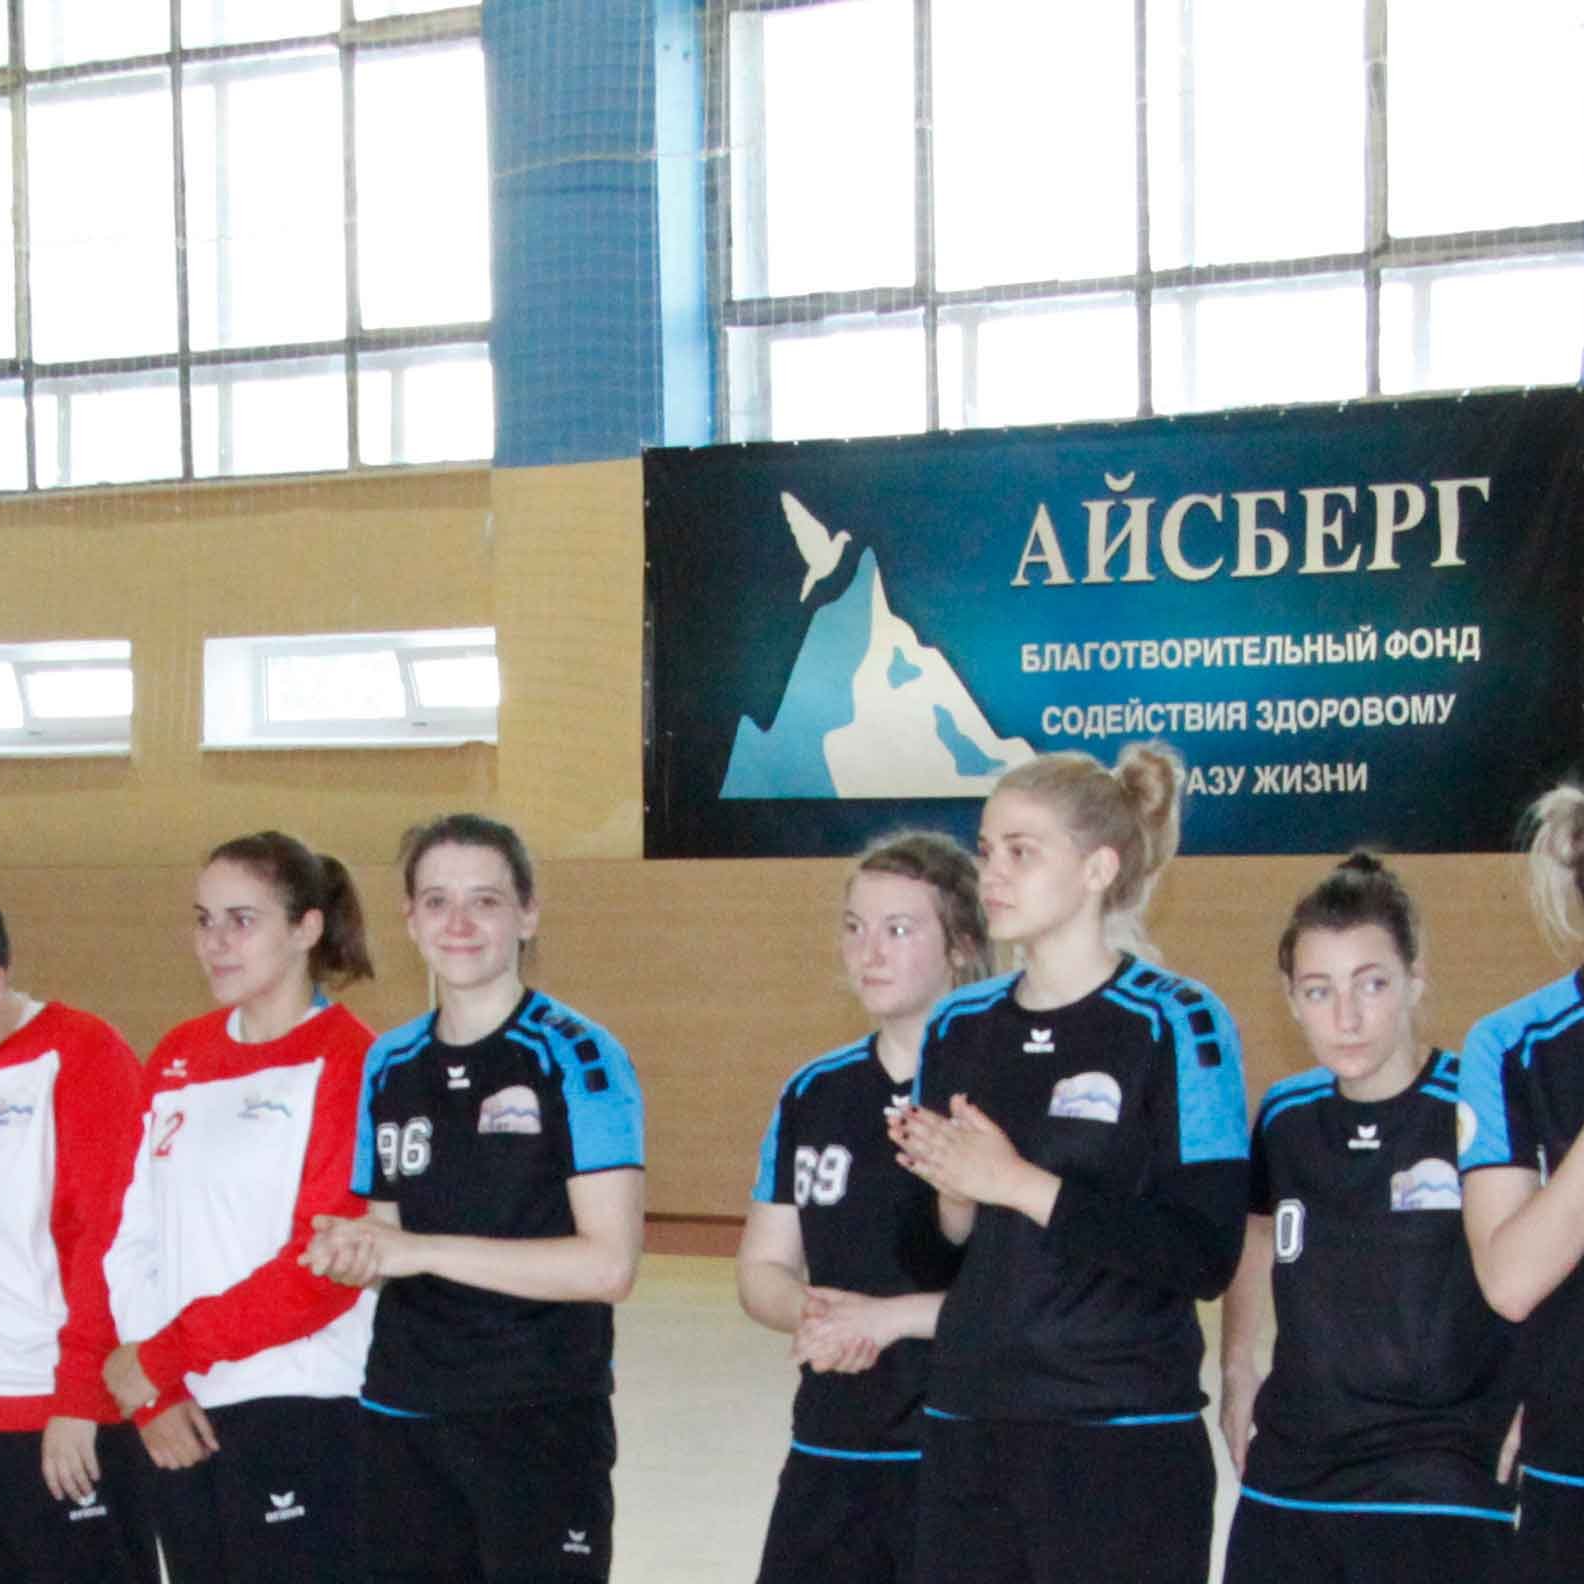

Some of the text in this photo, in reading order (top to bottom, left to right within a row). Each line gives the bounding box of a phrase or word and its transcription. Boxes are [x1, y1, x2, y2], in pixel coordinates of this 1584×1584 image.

[1010, 471, 1491, 587] АЙСБЕРГ
[1021, 625, 1482, 673] БЛАГОТВОРИТЕЛЬНЫЙ ФОНД
[1041, 693, 1457, 739] СОДЕЙСТВИЯ ЗДОРОВОМУ
[1251, 761, 1369, 796] ЖИЗНИ
[377, 1116, 433, 1182] 96
[794, 1144, 853, 1208] 69
